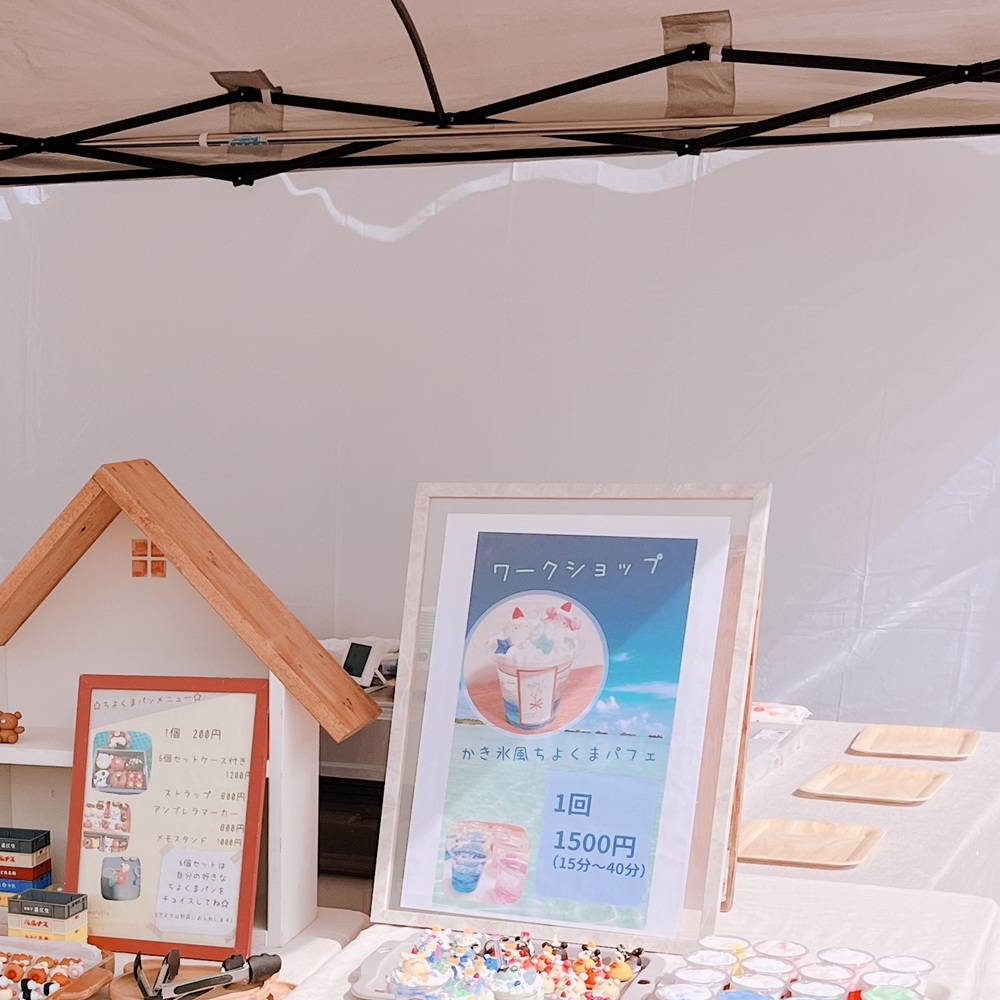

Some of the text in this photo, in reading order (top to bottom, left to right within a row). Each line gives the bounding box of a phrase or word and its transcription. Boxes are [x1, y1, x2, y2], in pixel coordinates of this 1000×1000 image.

[493, 552, 664, 582] ワークショップ
[164, 727, 222, 741] 1個 200円
[165, 789, 246, 802] ストラップ 800円
[553, 792, 593, 817] 1回
[219, 823, 245, 834] 800円
[156, 834, 208, 844] メモスタンド
[553, 830, 637, 858] 1500円
